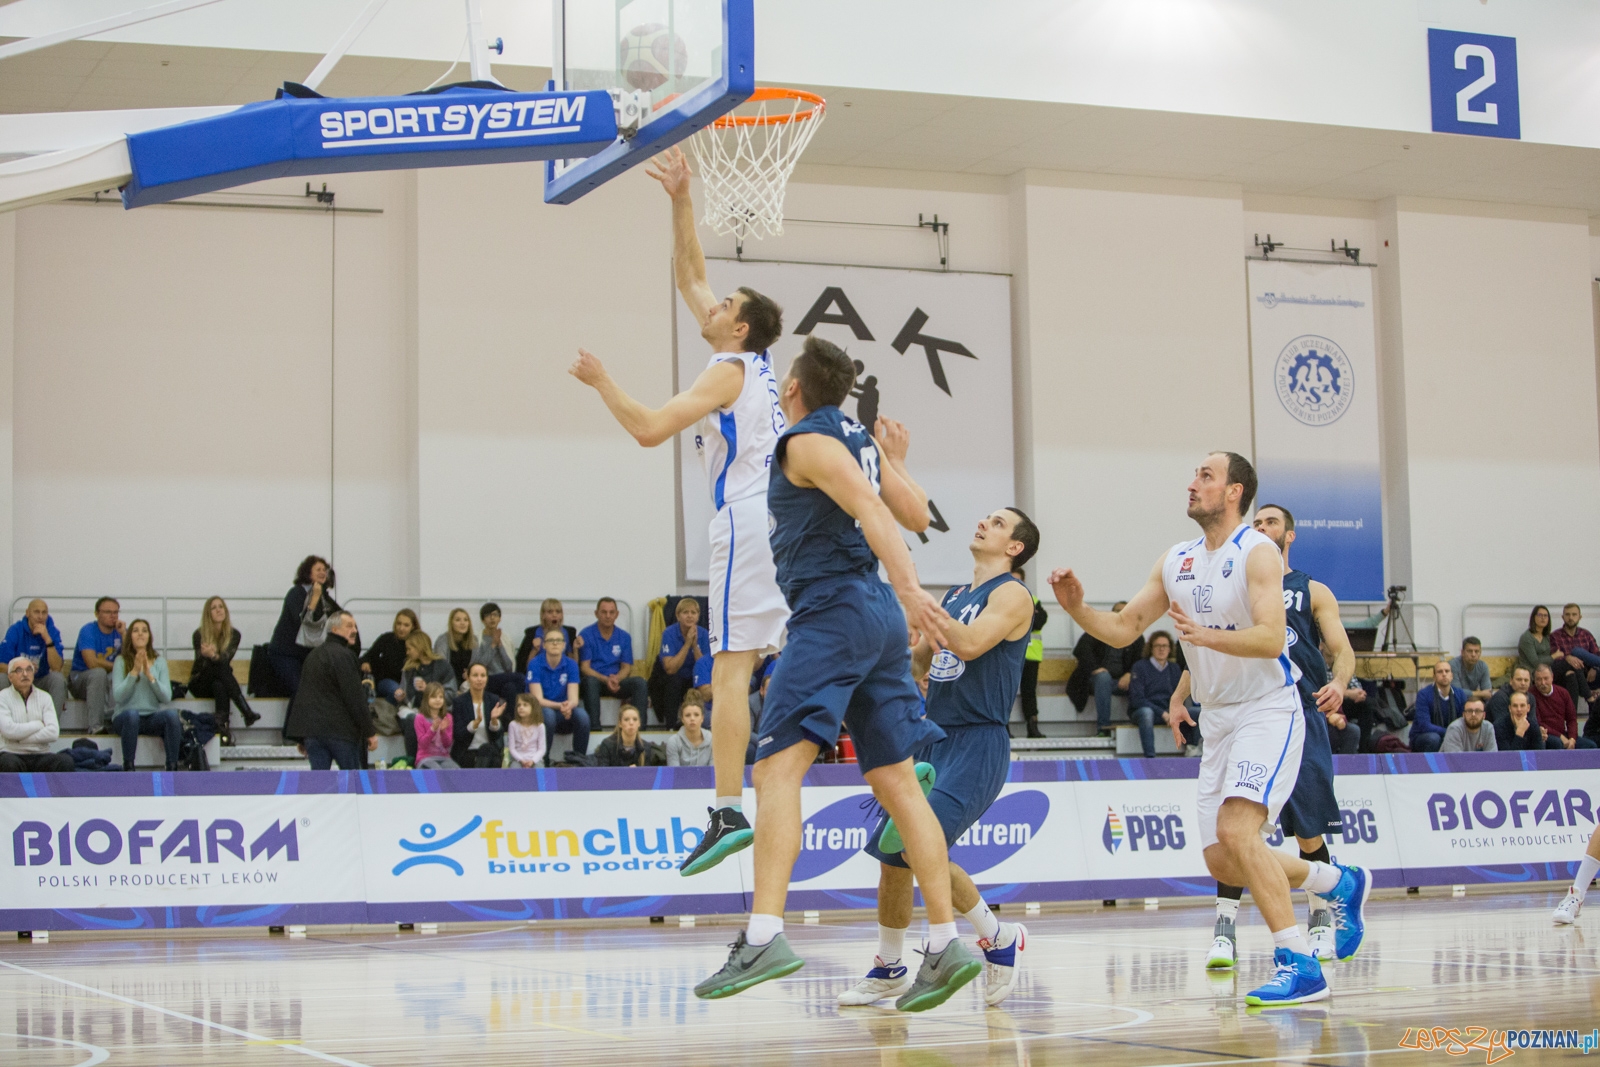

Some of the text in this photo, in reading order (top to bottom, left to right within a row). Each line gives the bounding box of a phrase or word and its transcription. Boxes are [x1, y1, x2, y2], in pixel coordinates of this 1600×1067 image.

[1454, 43, 1498, 125] 2
[320, 96, 586, 139] SPORTSYSTEM
[1283, 339, 1346, 367] KLUB UCZELNIANY
[1293, 518, 1363, 529] .azs.put.poznan.pl
[1192, 585, 1213, 613] 12
[1237, 760, 1268, 787] 12
[1122, 802, 1181, 814] fundacja
[1337, 797, 1373, 809] dacja
[1427, 788, 1600, 831] BIOFAR
[480, 816, 706, 859] funclub
[800, 822, 868, 851] trem
[1125, 813, 1187, 852] PBG
[1325, 808, 1379, 846] BG
[12, 817, 300, 866] BIOFARM
[1451, 838, 1495, 849] POLSKI
[1501, 834, 1573, 847] PRODUCENT
[38, 869, 279, 888] POLSKI PRODUCENT LEKÓW
[488, 859, 571, 875] biuro
